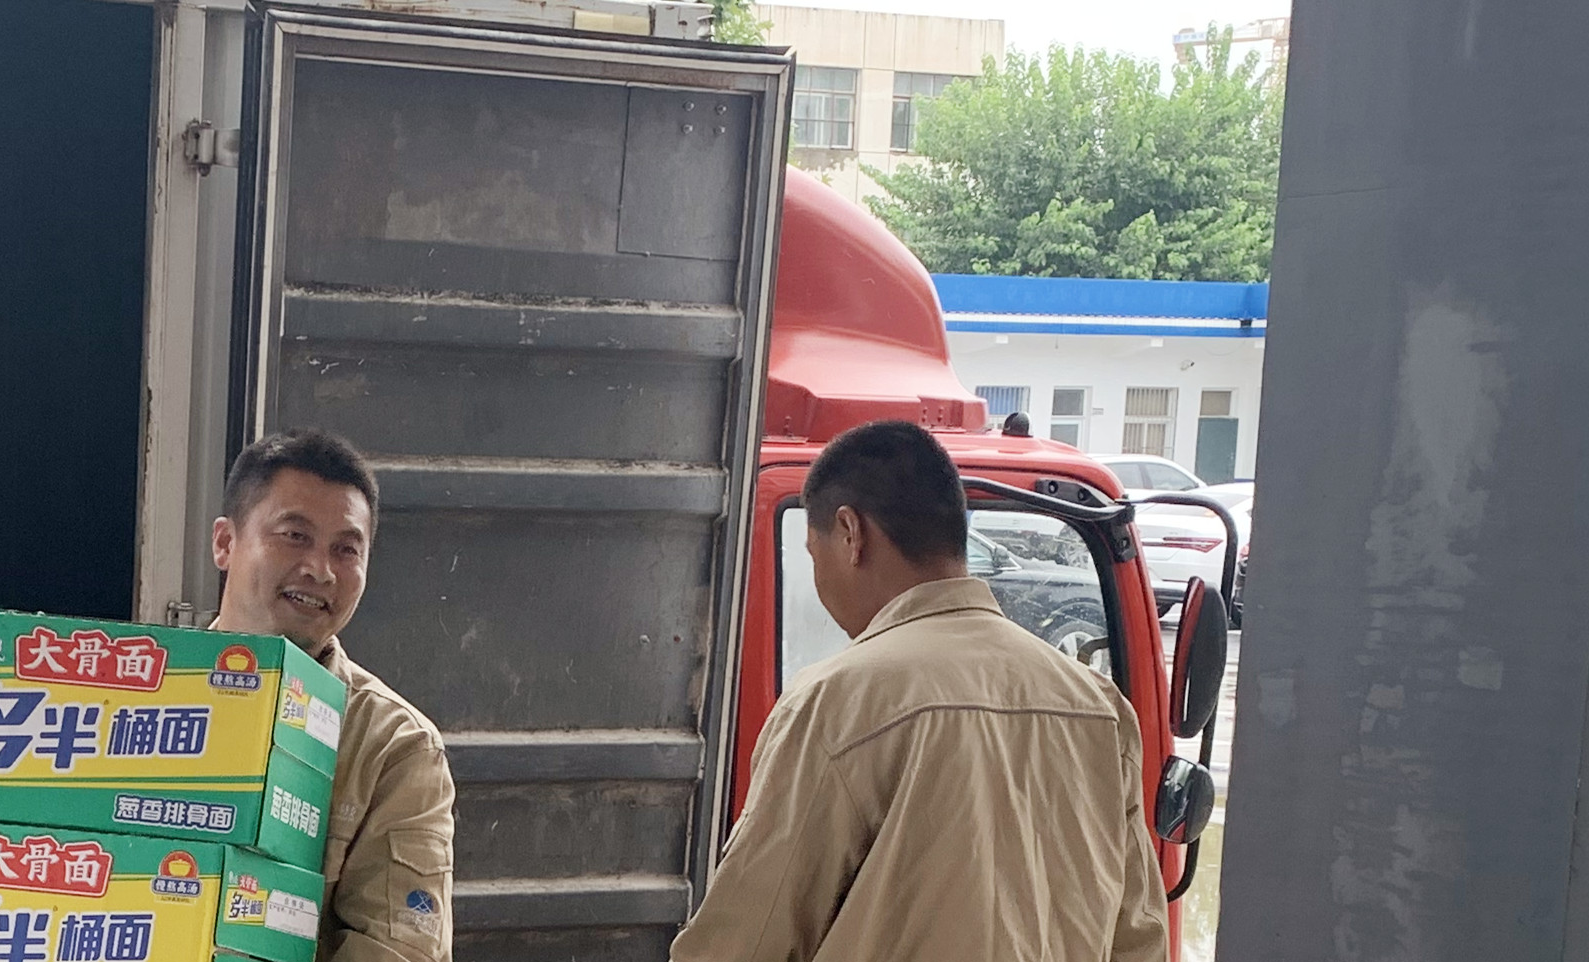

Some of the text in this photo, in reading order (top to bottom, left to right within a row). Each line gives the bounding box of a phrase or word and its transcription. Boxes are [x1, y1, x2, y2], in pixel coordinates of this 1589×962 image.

[21, 629, 155, 684] 大骨面
[116, 795, 235, 831] 葱香排骨面
[269, 784, 321, 838] 葱香排骨面
